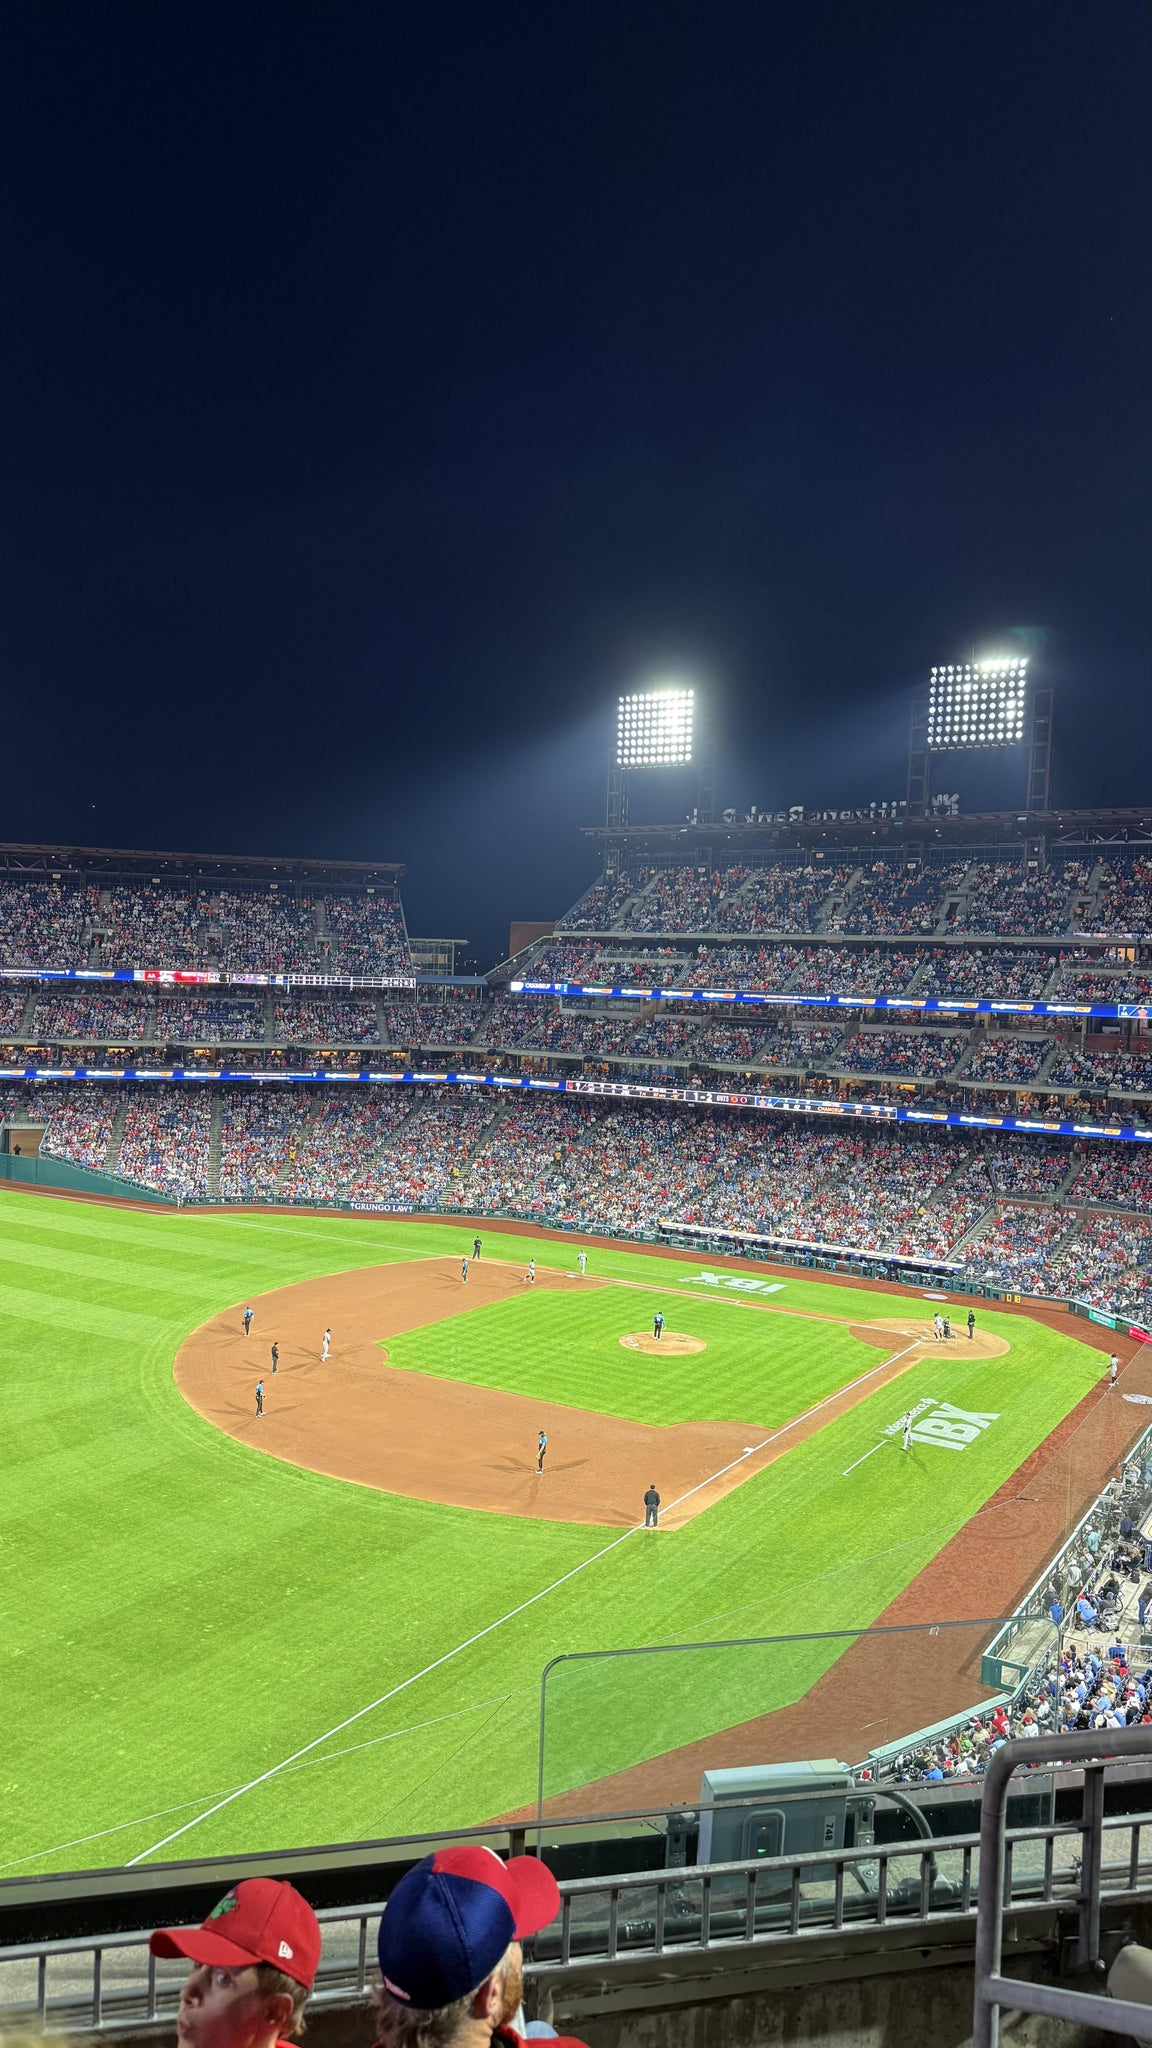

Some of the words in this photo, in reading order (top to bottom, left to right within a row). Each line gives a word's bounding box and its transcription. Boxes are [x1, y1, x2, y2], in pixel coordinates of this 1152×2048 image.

[817, 1106, 845, 1114] CHANGEUP
[354, 1202, 391, 1211] GRUNGO
[686, 1271, 788, 1294] IBX
[909, 1401, 1002, 1451] IBX
[824, 1822, 834, 1841] 748
